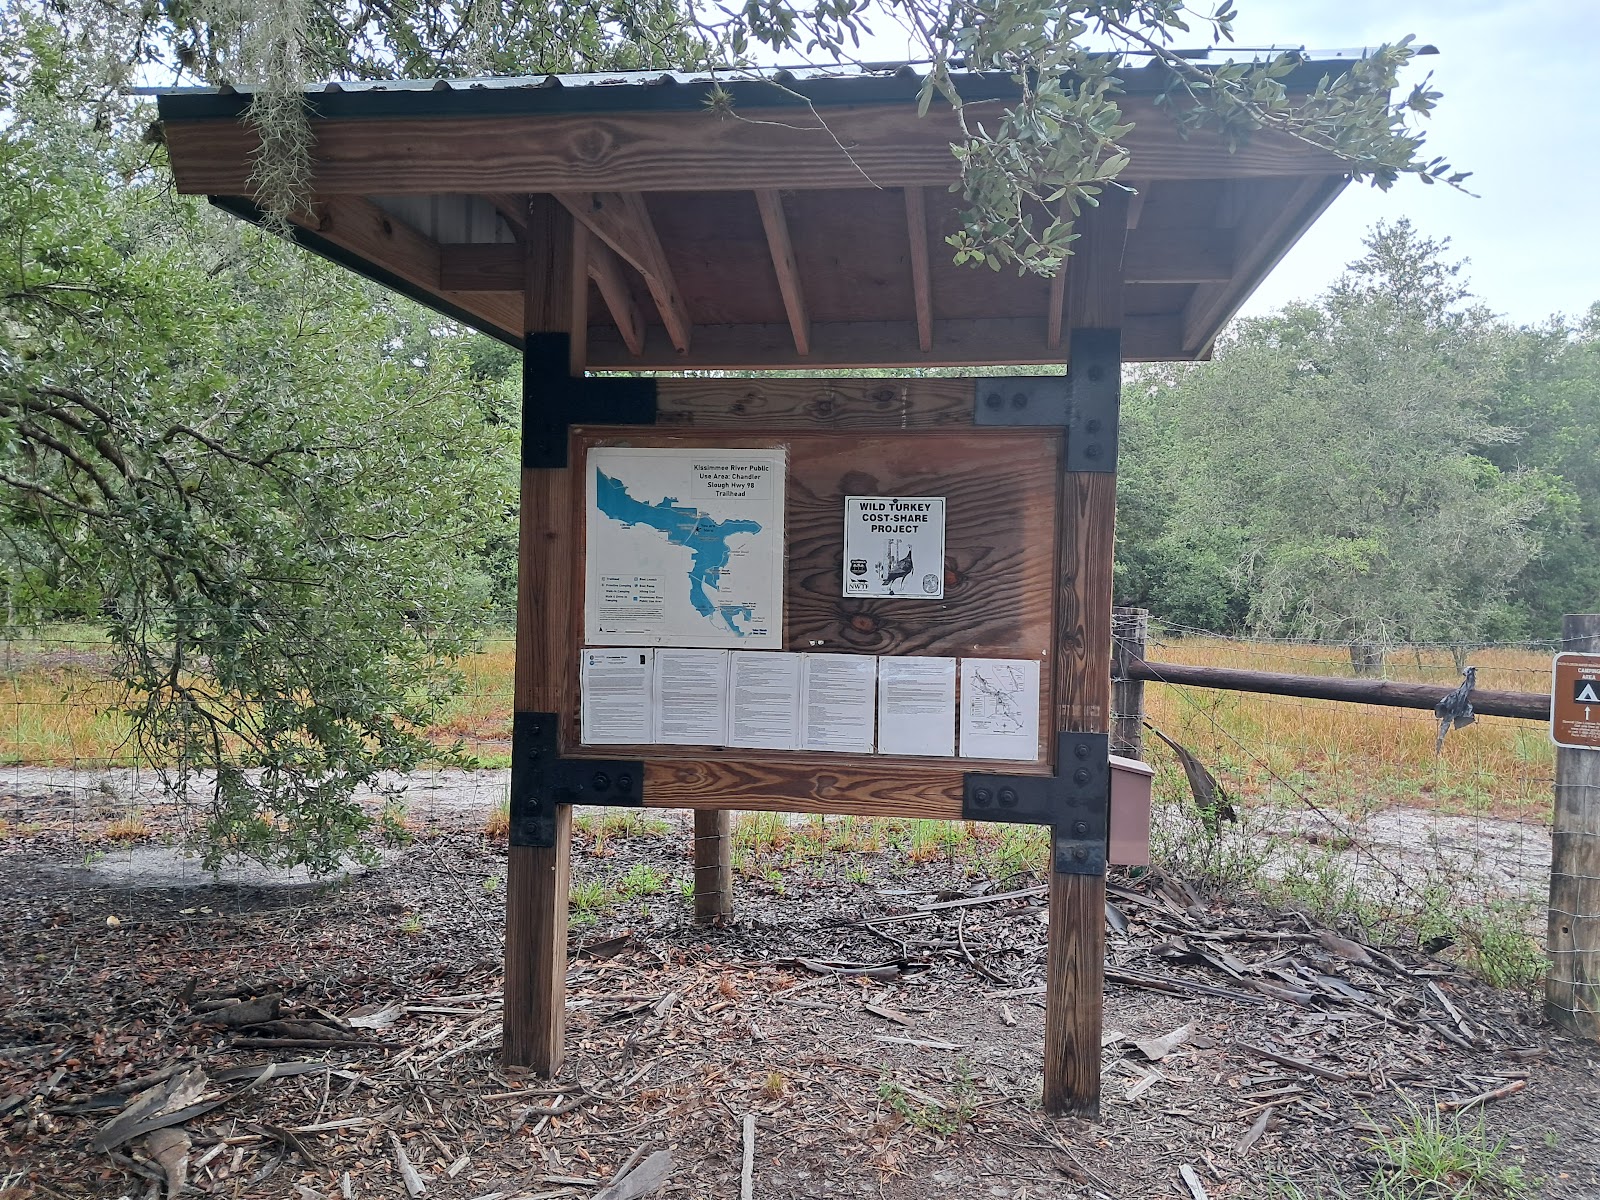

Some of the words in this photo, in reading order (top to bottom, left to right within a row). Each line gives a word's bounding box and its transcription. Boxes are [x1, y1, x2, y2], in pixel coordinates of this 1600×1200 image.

[707, 481, 729, 489] Slough
[859, 502, 886, 511] WILD
[889, 503, 931, 512] TURKEY
[862, 513, 928, 522] COST-SHARE
[871, 524, 919, 533] PROJECT
